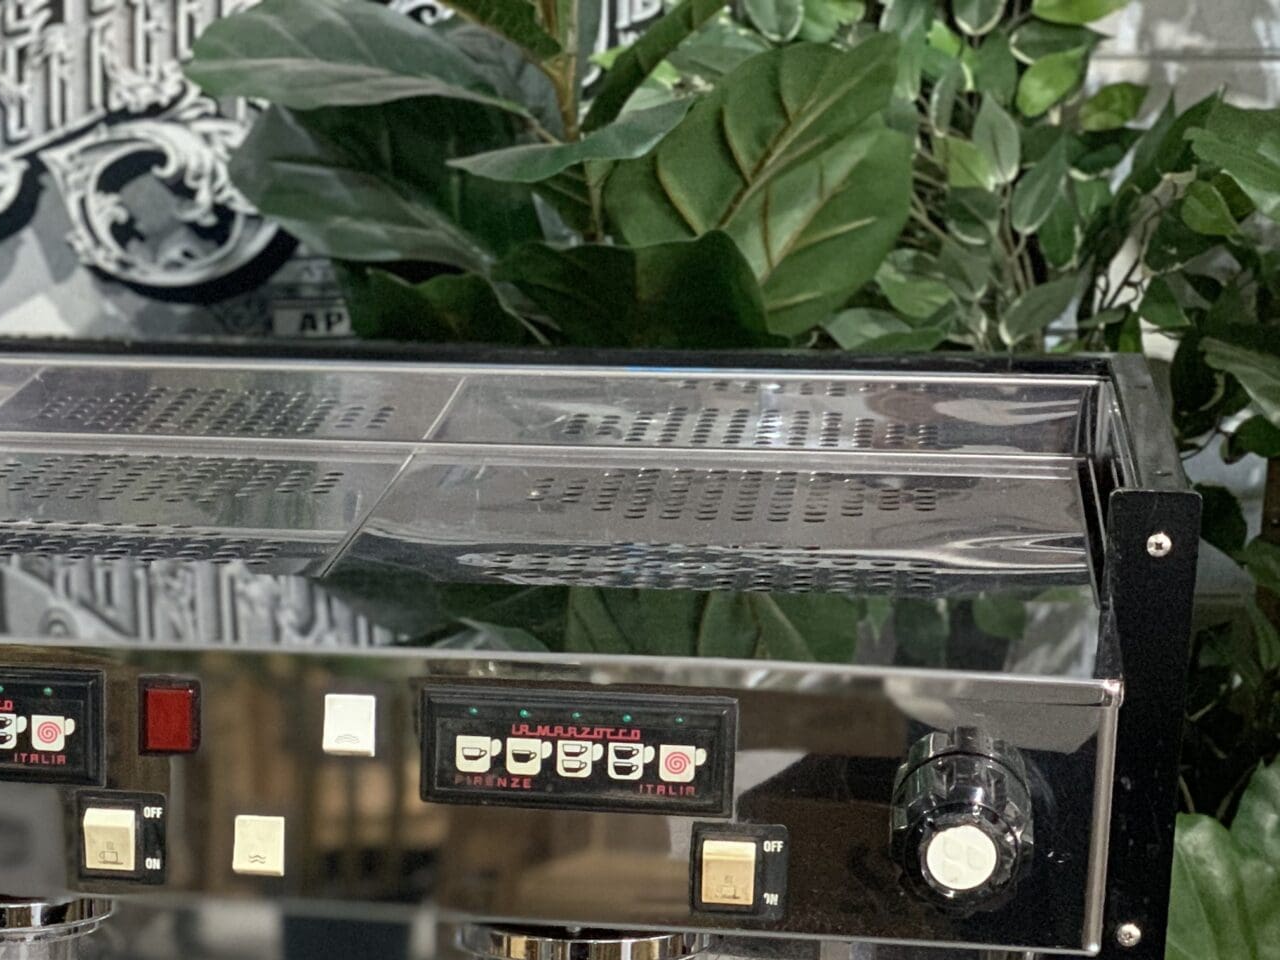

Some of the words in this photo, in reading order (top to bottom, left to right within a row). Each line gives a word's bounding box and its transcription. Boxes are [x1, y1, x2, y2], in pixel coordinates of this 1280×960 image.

[14, 752, 66, 765] ITALIA
[639, 783, 696, 796] ITALIA
[143, 806, 163, 819] OFF
[763, 840, 784, 853] OFF
[145, 857, 161, 870] ON
